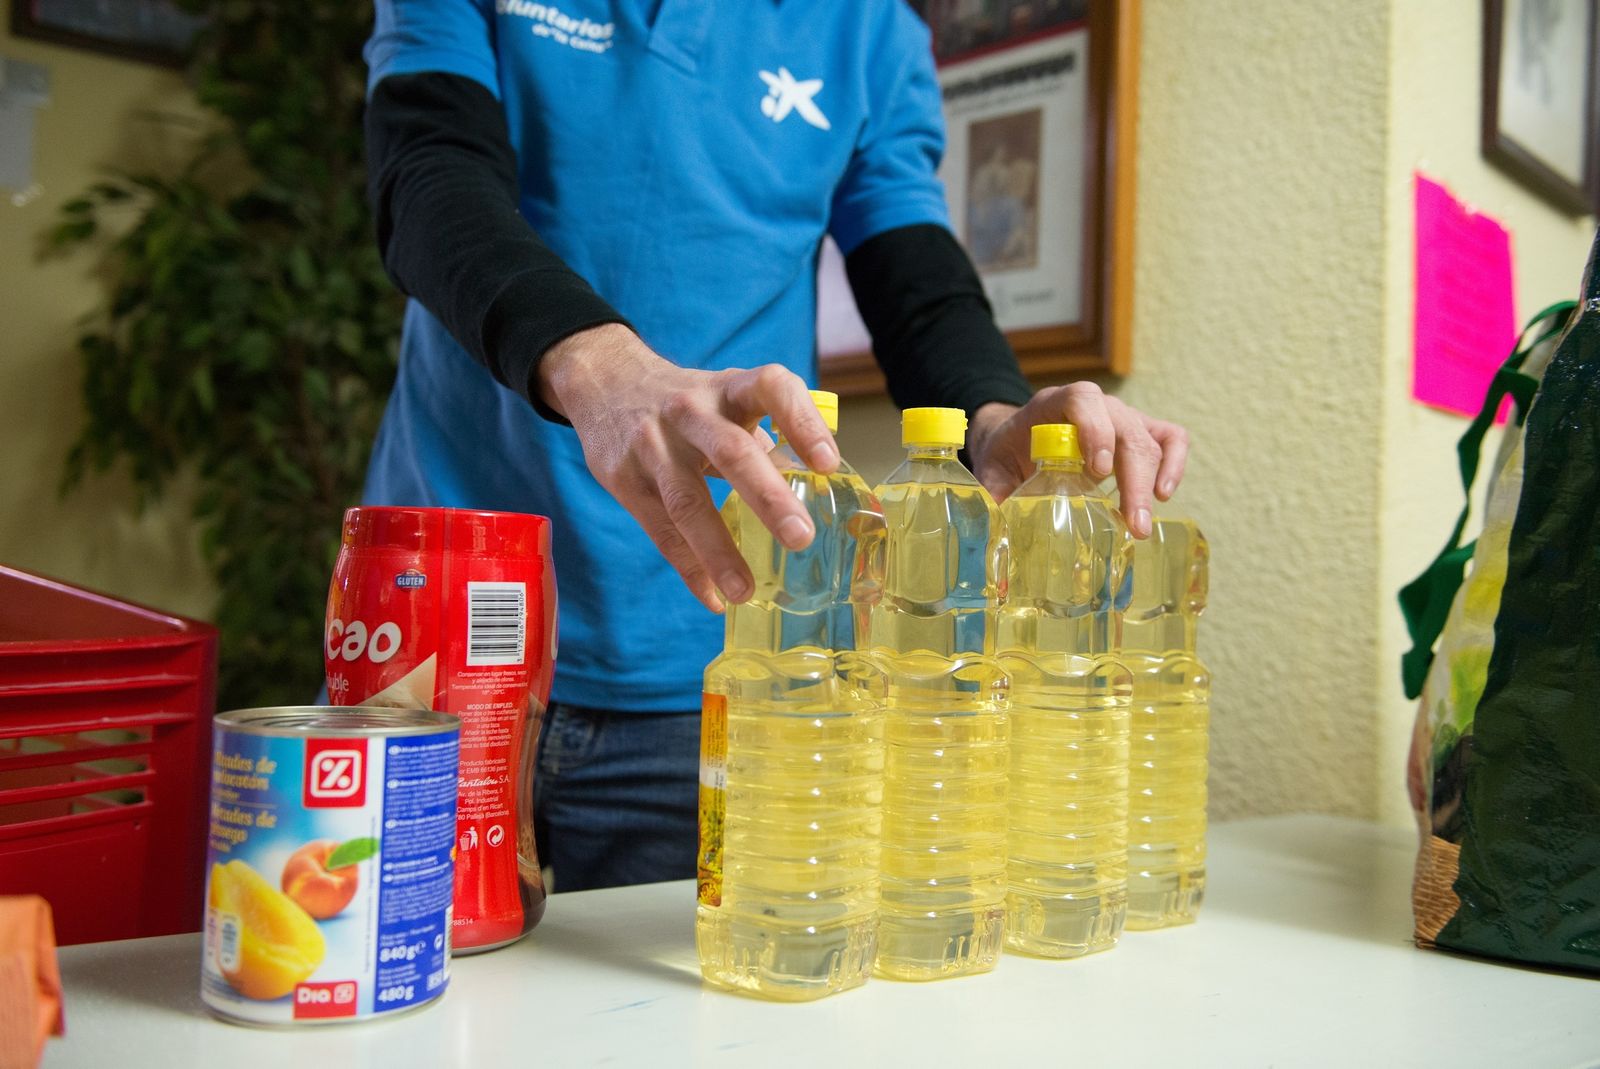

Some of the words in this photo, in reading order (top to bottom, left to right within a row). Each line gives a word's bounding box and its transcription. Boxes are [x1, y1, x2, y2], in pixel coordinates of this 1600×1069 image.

[397, 576, 425, 586] GLUTEN
[256, 756, 277, 774] de
[256, 811, 277, 828] de
